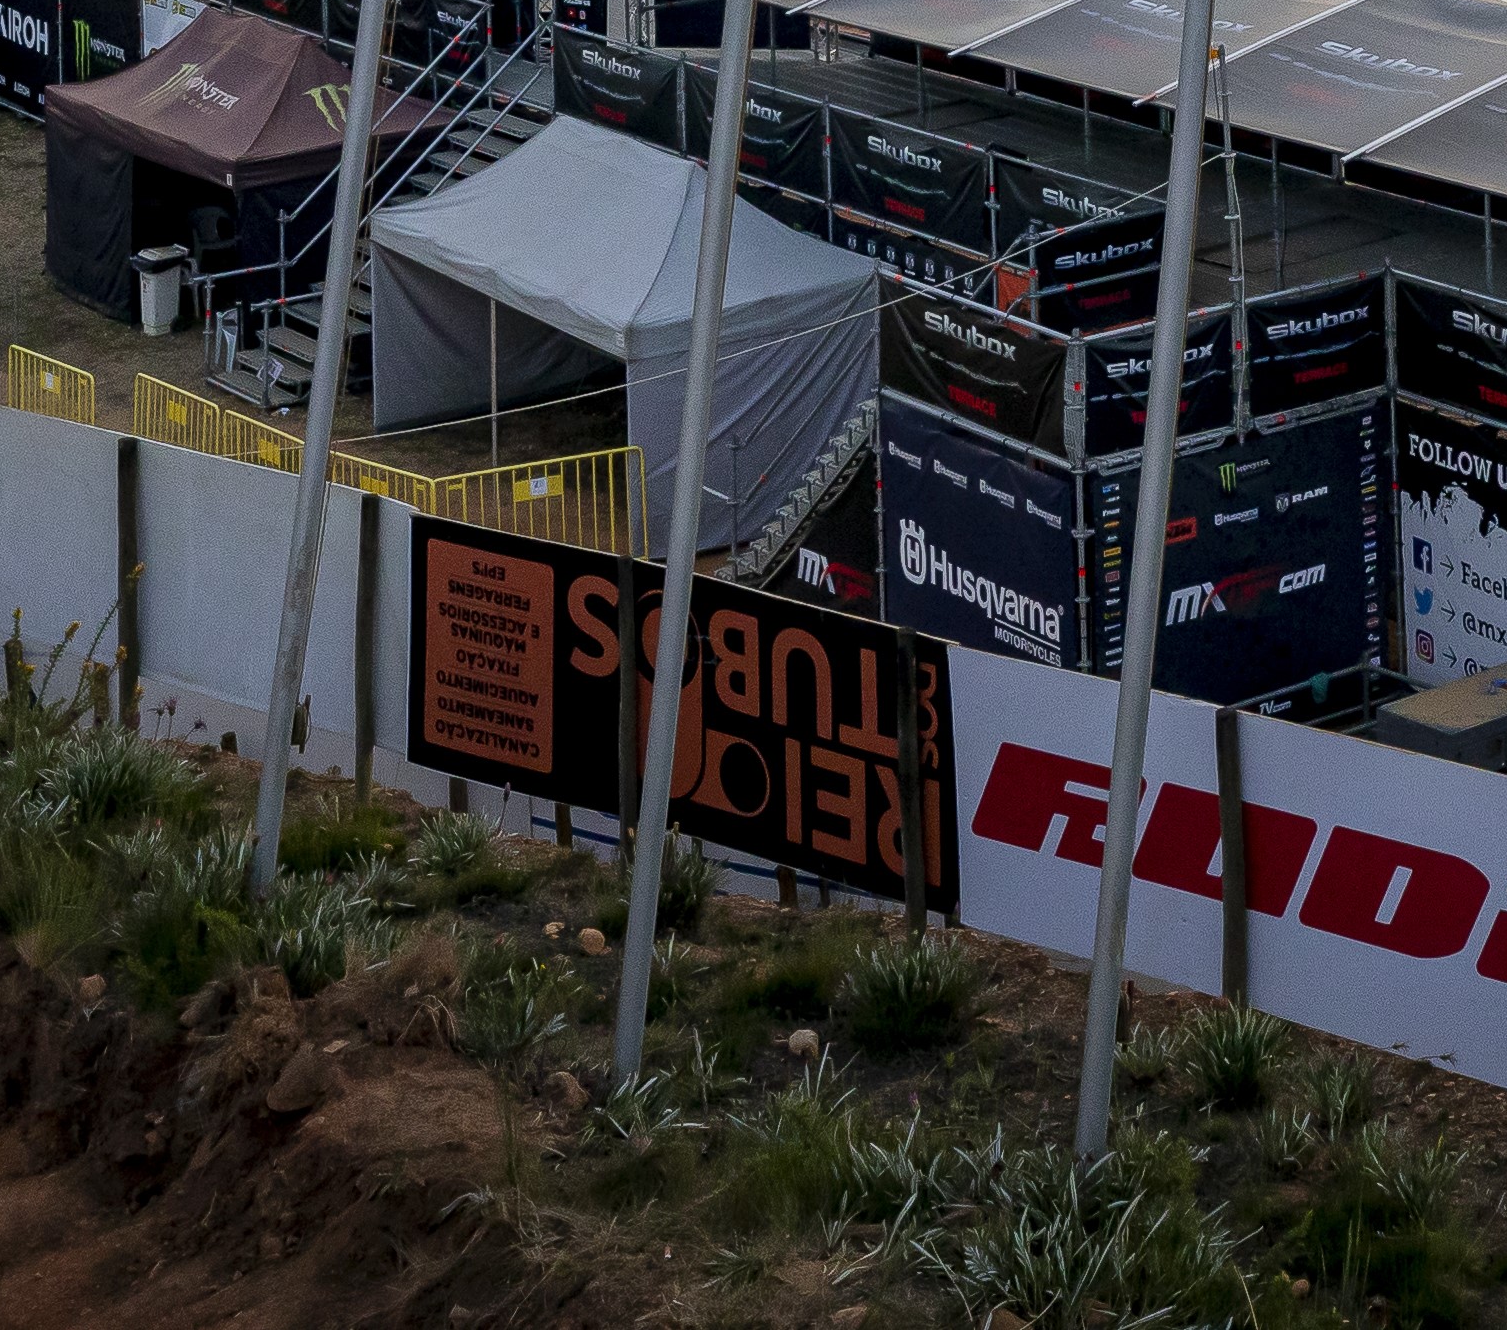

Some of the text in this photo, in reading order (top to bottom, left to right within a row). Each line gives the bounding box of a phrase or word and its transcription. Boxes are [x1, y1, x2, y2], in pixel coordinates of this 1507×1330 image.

[867, 135, 942, 173] Skybox
[924, 310, 1018, 362] Skybox
[1266, 304, 1370, 339] Skybox
[1409, 434, 1493, 484] FOLLOW
[1292, 485, 1328, 505] RAM
[929, 544, 1061, 642] Husqvarna
[994, 625, 1062, 667] MOTORCYCLES
[435, 666, 539, 710] AQUECIMENTO
[435, 692, 534, 735] SANEAMENTO
